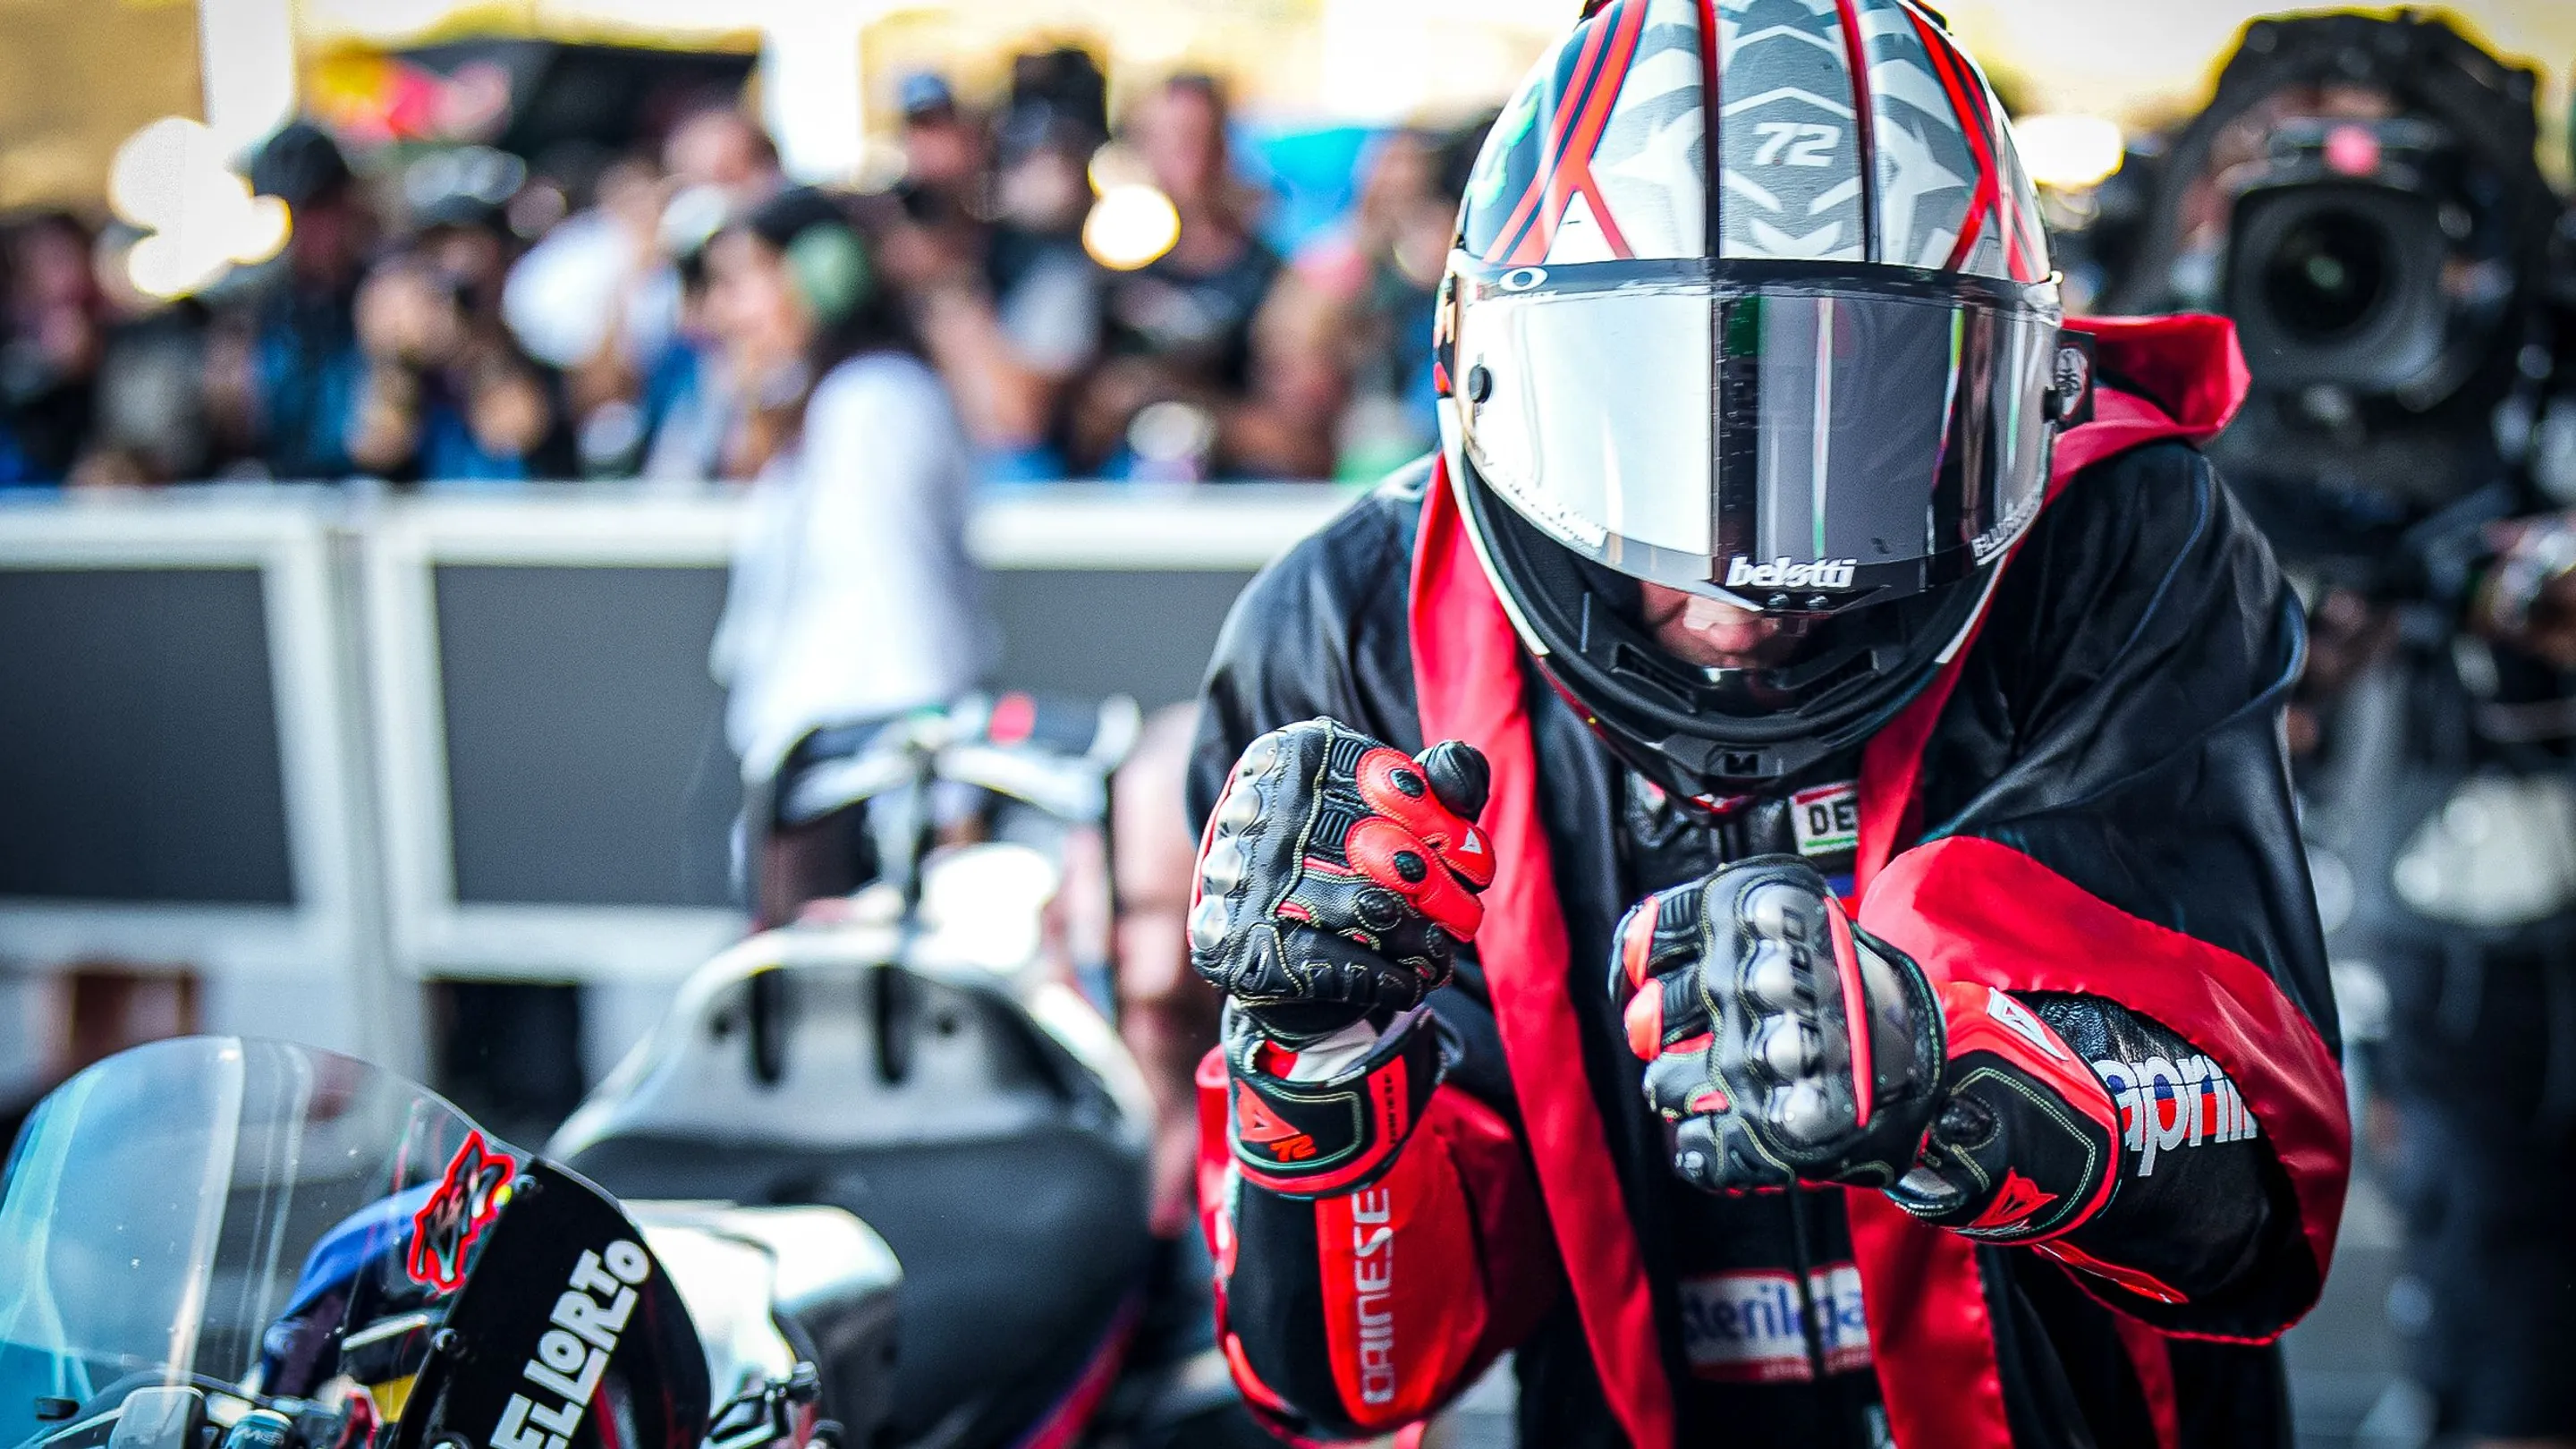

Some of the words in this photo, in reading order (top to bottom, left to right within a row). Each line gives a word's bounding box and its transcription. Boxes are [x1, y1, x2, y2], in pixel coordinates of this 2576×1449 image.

[1752, 122, 1843, 167] 72
[1725, 555, 1858, 588] belotti
[1352, 1187, 1395, 1405] DAINESE
